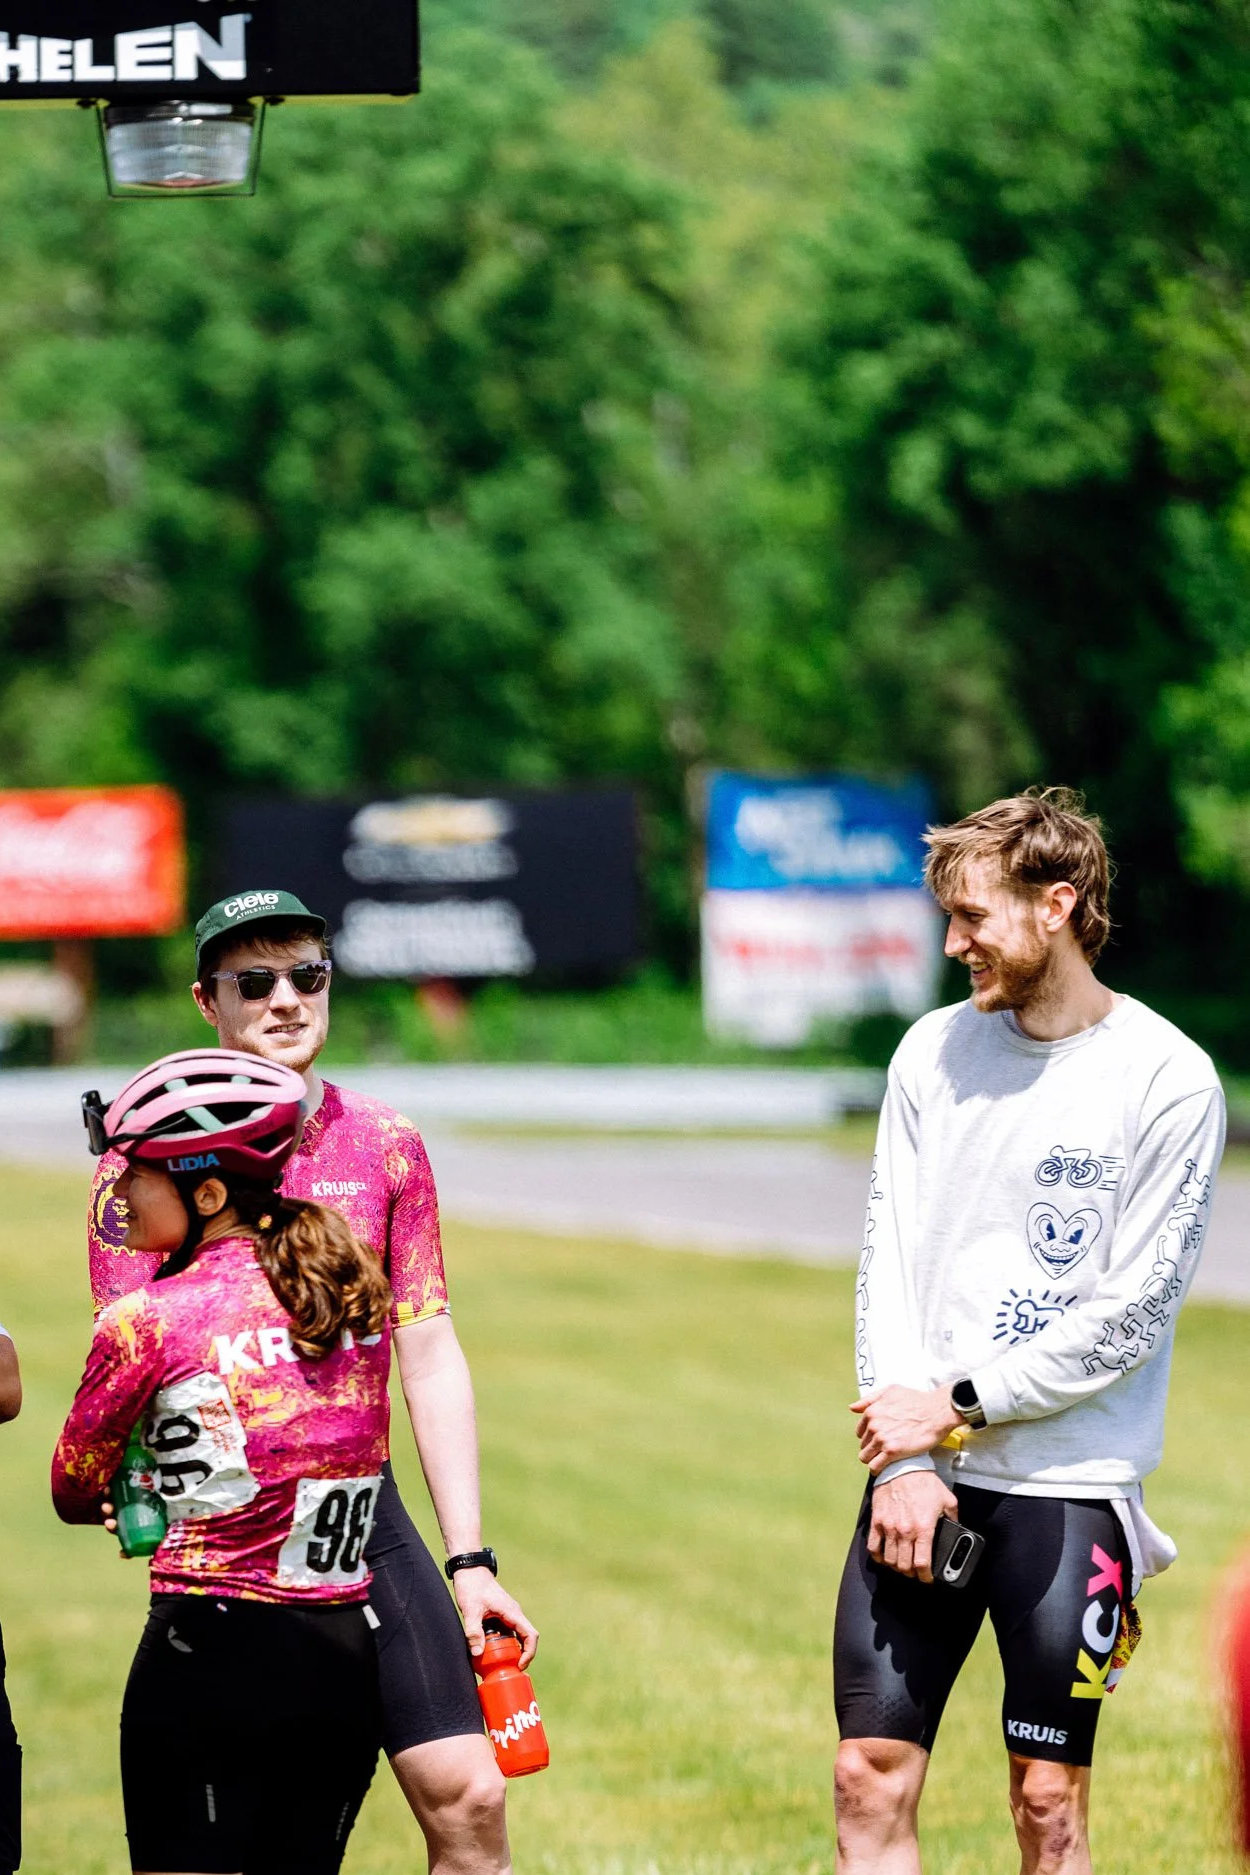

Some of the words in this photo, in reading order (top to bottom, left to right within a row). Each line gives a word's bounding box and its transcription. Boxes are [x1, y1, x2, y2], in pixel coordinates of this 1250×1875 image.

[236, 905, 275, 921] ATHLETICS
[167, 1152, 220, 1172] LIDIA
[1070, 1543, 1123, 1699] KCX
[1007, 1719, 1068, 1745] KRUIS
